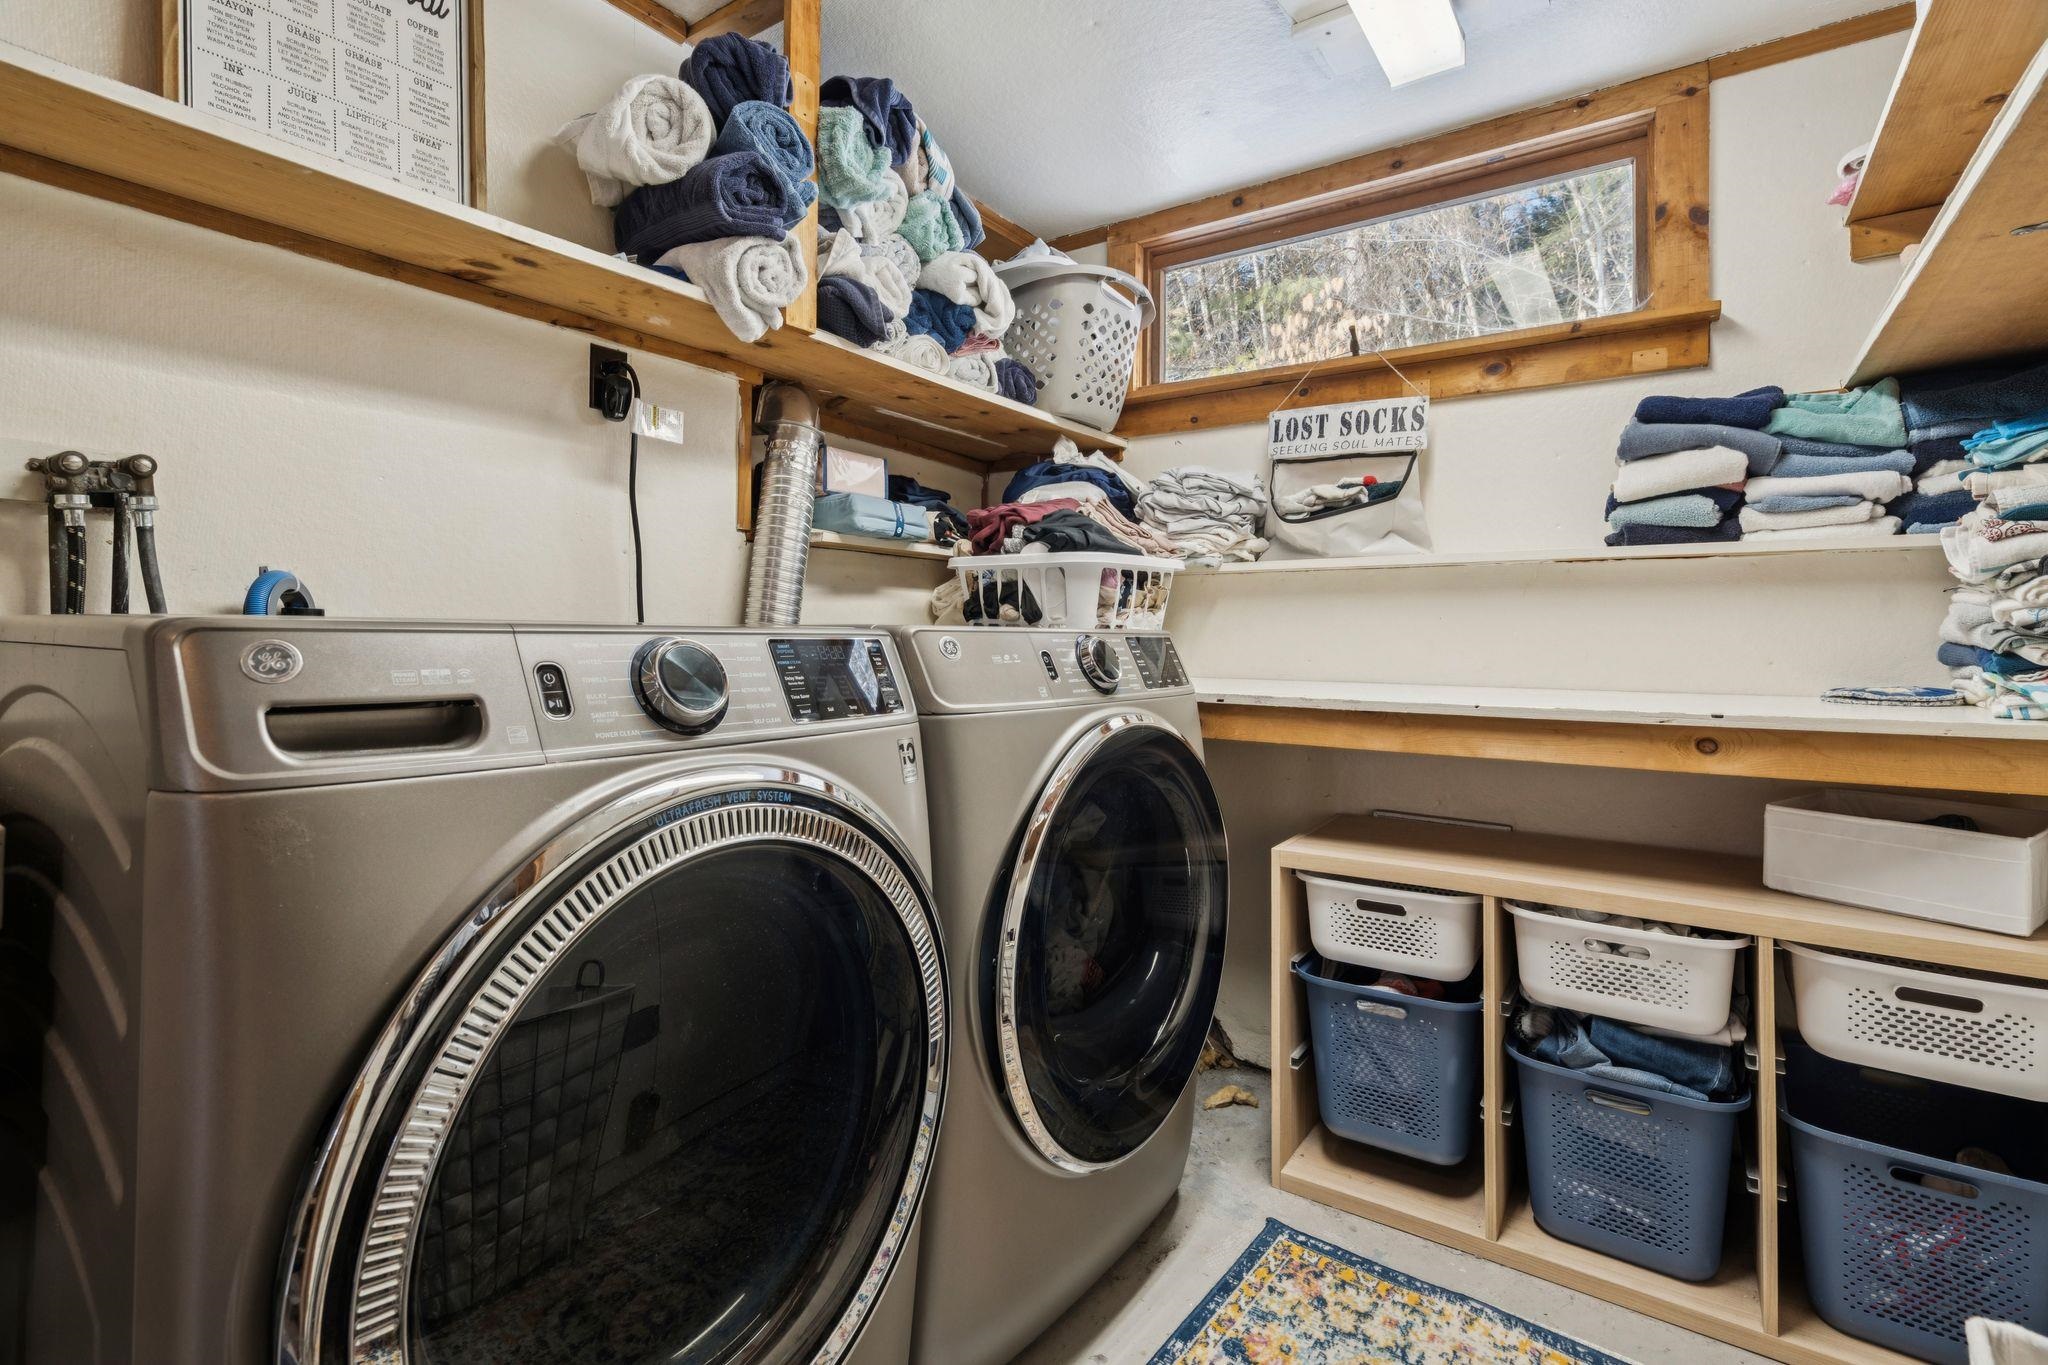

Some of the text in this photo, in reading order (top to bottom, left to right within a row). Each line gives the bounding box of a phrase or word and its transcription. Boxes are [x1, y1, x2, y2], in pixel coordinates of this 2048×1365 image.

[207, 5, 255, 28] IRON BETWEEN
[212, 0, 253, 17] AYON
[207, 20, 256, 42] TOWELS SPRAY
[214, 15, 250, 33] TWO PAPER
[406, 18, 440, 39] COFFEE
[206, 28, 258, 51] WITH WD-40 AND
[286, 24, 321, 45] GRASS
[206, 35, 226, 46] WASH
[236, 47, 256, 58] USUAL
[277, 40, 329, 65] RUBBING ALCOHOL
[286, 37, 321, 55] SCRUB WITH
[223, 61, 244, 76] INK
[345, 48, 382, 70] GREASE
[210, 72, 253, 91] USE RUBBING
[212, 81, 241, 95] ALCOHOL
[413, 77, 433, 91] GUM
[214, 90, 249, 104] HAIRSPRAY
[214, 96, 251, 112] THEN WASH
[288, 86, 318, 104] JUICE
[215, 103, 234, 113] COLD
[234, 111, 257, 122] WATER
[286, 100, 322, 117] SCRUB WITH
[277, 111, 331, 134] AND DISHWASHING
[346, 108, 388, 131] LIPSTICK
[277, 119, 331, 142] LIQUID THEN WASH
[289, 130, 305, 140] COLD
[306, 136, 326, 147] WATER
[412, 133, 442, 151] SWEAT
[1273, 405, 1425, 443] LOST SOCKS
[1272, 435, 1422, 456] SEEKING SOUL MATES
[595, 730, 640, 740] POWER CLEAN
[656, 790, 792, 827] ULTRAFRESH VENT SYSTEM
